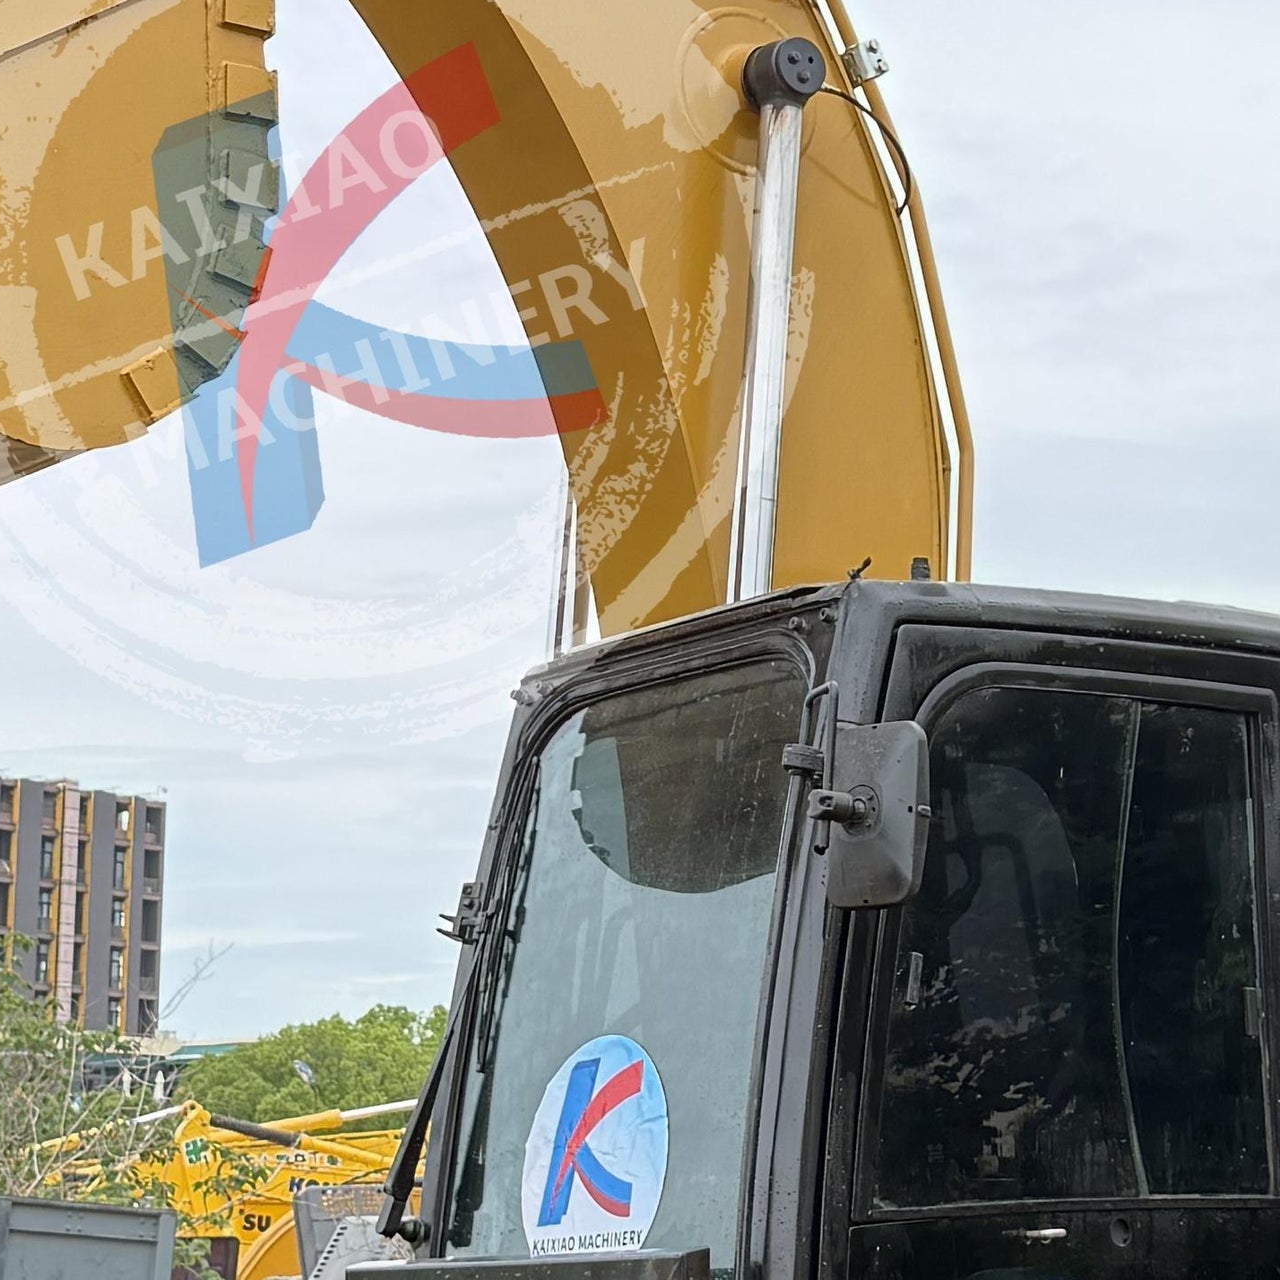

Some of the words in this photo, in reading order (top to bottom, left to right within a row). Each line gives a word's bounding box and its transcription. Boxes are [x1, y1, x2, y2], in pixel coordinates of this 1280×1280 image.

[239, 1208, 272, 1233] SU
[532, 1236, 576, 1256] KAIXIAO
[578, 1229, 644, 1250] MACHINERY
